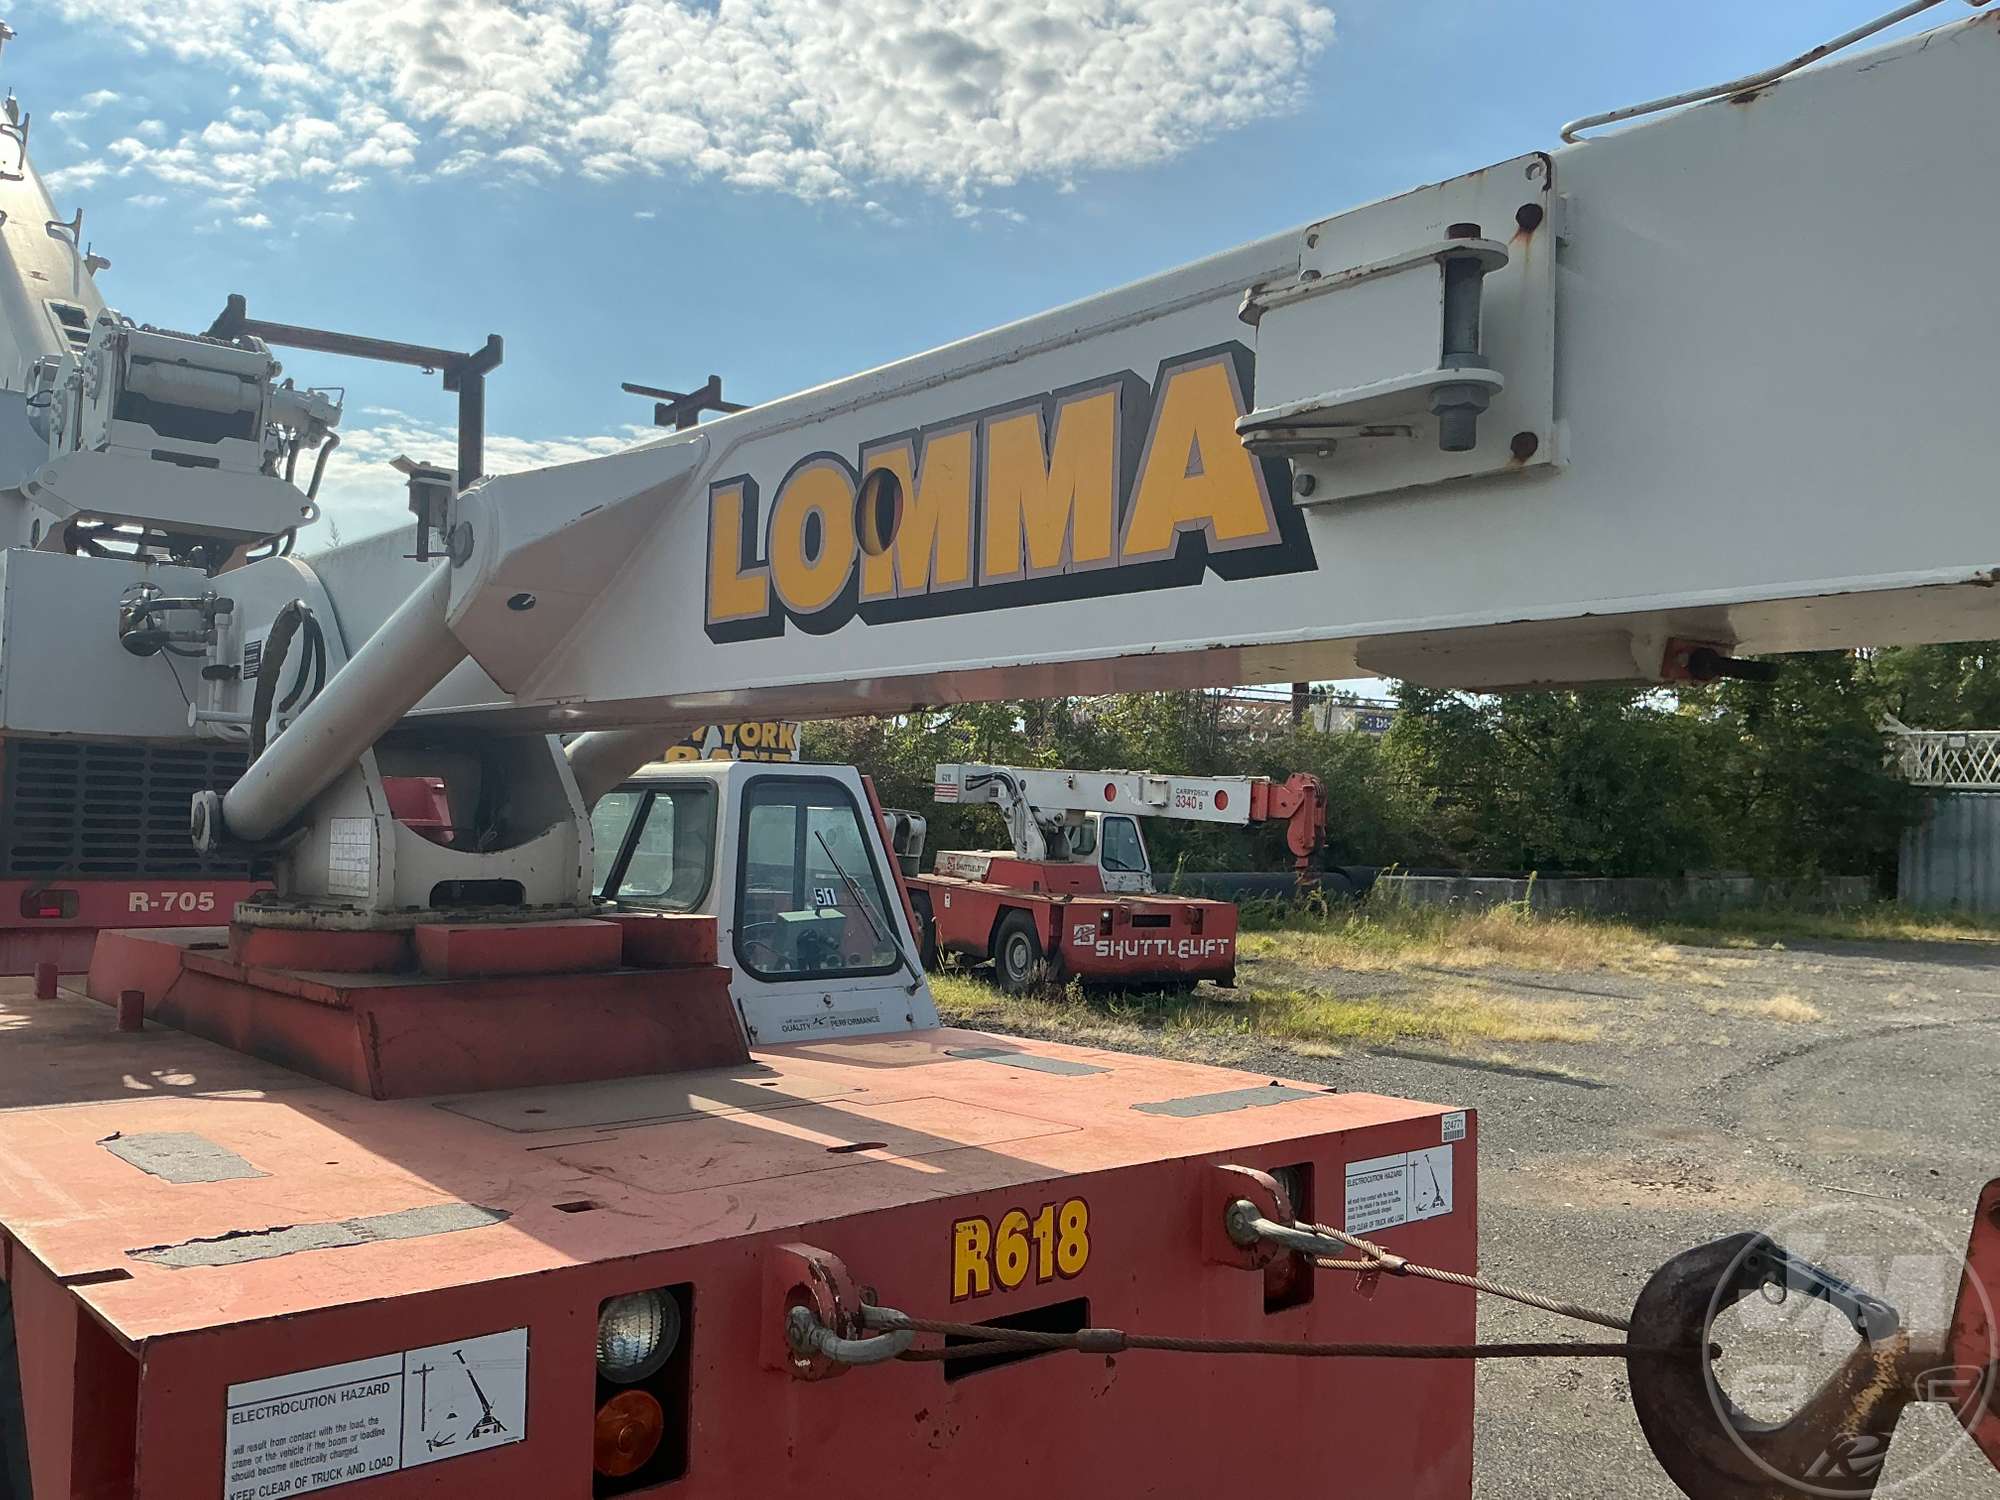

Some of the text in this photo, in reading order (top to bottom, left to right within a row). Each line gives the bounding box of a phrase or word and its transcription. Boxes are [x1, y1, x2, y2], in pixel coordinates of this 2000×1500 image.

[705, 341, 1306, 641] LOMMA
[1175, 795, 1197, 809] 3340
[128, 891, 215, 912] R-705
[814, 888, 835, 905] 51
[1095, 938, 1231, 961] SHUTTLELIFT
[781, 1015, 881, 1033] QUALITY PERFORMANCE
[951, 1197, 1091, 1303] R618
[232, 1382, 390, 1425] ELECTROCUTION HAZARD
[255, 1455, 263, 1464] or
[265, 1451, 277, 1461] the
[280, 1445, 304, 1458] vehicle
[306, 1442, 312, 1452] if
[314, 1440, 326, 1449] the
[328, 1436, 348, 1448] boom
[350, 1433, 358, 1442] or
[270, 1436, 287, 1448] from
[289, 1430, 316, 1443] contact
[319, 1425, 333, 1437] with
[335, 1423, 347, 1433] the
[231, 1470, 255, 1482] should
[258, 1463, 286, 1476] become
[289, 1452, 327, 1469] electrically
[258, 1480, 291, 1498] CLEAR
[294, 1475, 308, 1489] OF
[311, 1467, 343, 1485] TRUCK
[346, 1462, 366, 1476] AND
[368, 1455, 394, 1471] LOAD
